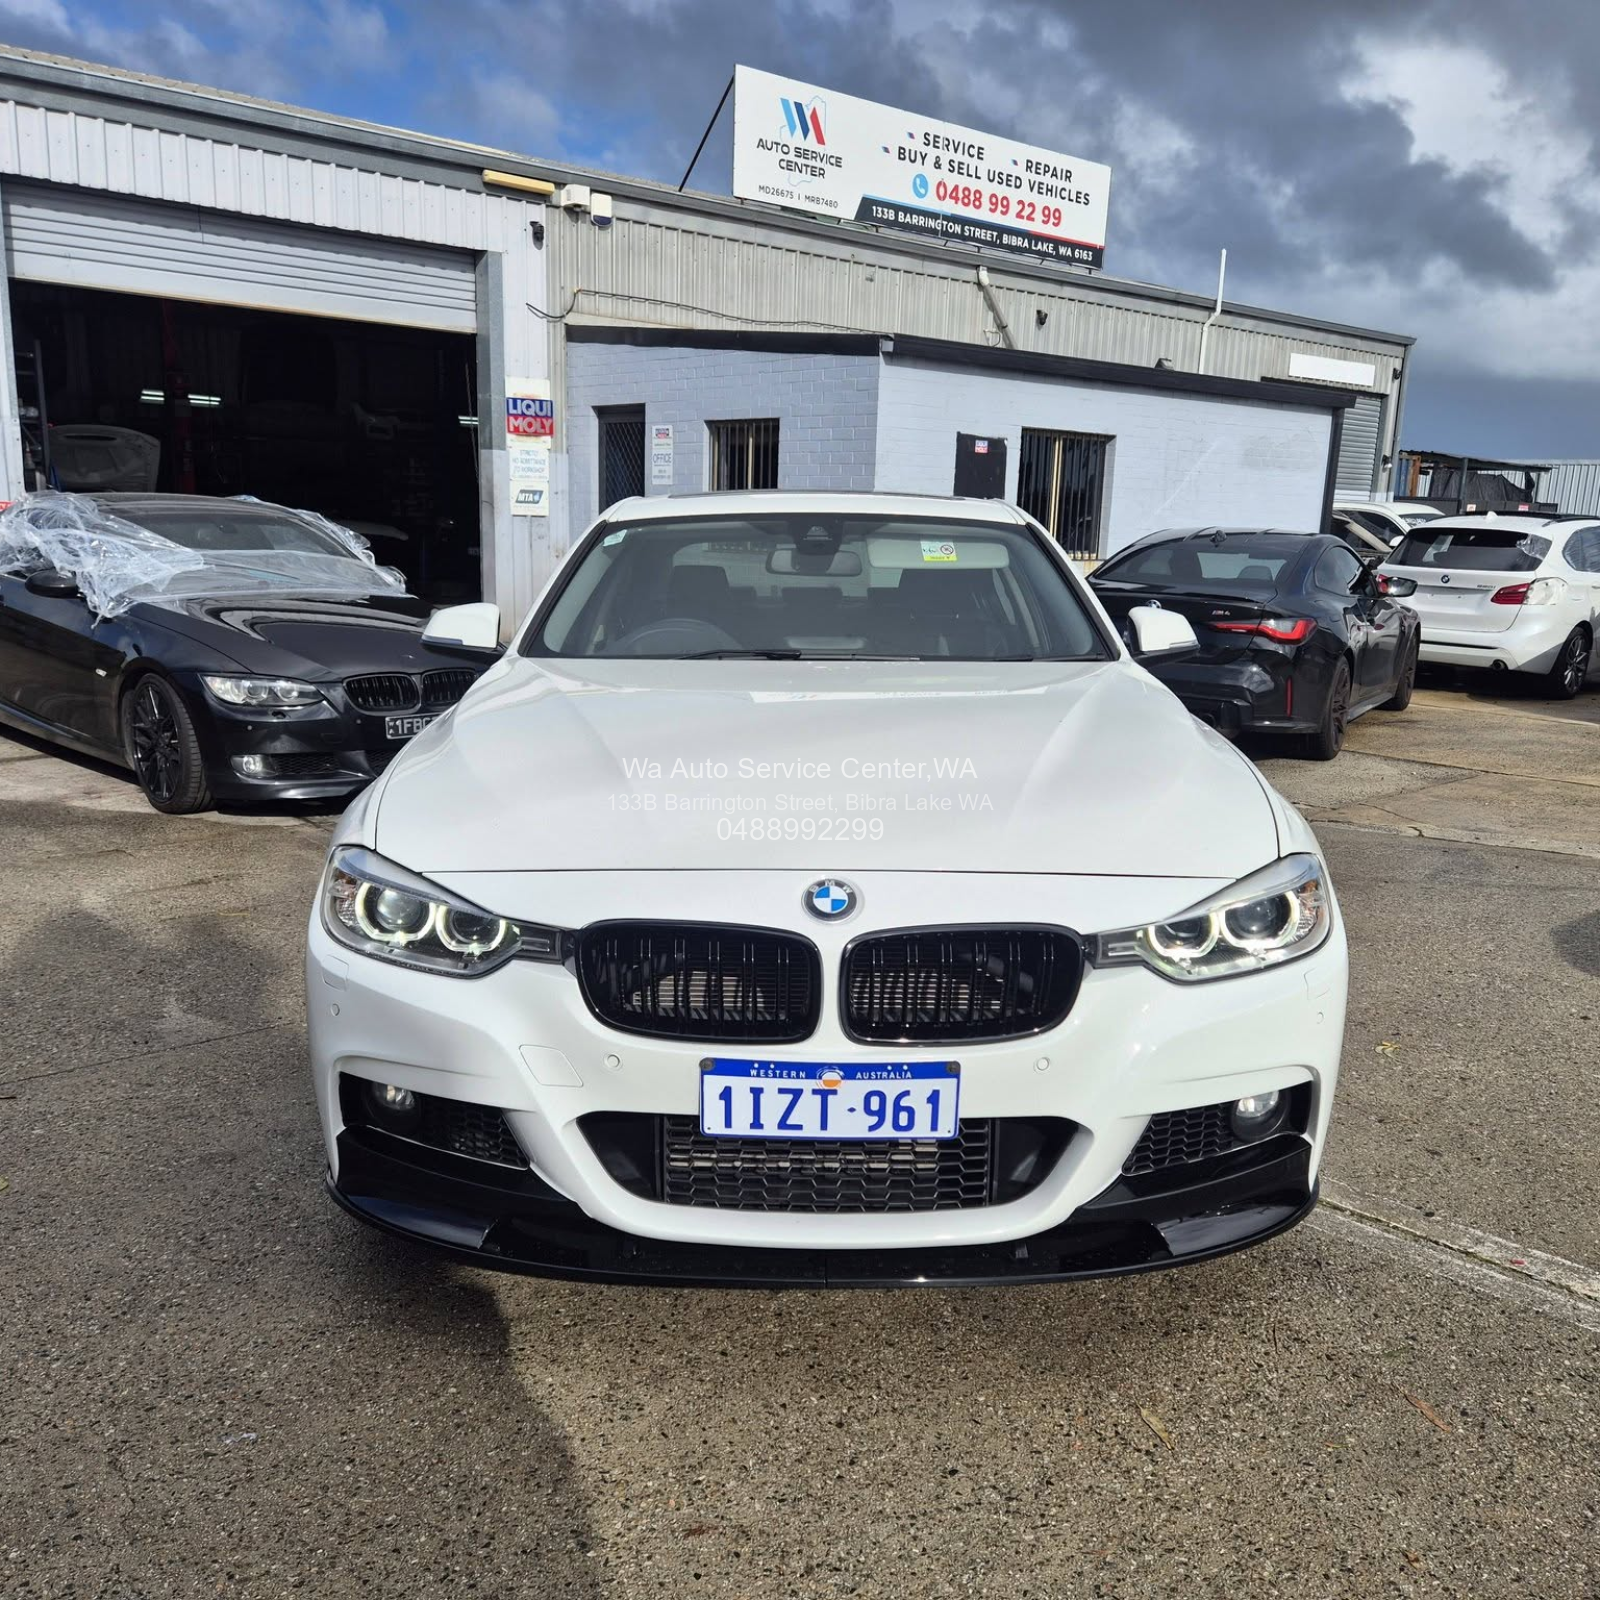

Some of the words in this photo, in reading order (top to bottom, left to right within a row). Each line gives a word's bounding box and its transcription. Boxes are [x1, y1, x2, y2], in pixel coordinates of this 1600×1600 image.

[756, 138, 791, 155] AUTO
[793, 146, 843, 168] SERVICE
[923, 131, 985, 161] SERVICE
[778, 158, 826, 179] CENTER
[897, 145, 928, 166] BUY
[933, 155, 942, 170] &
[948, 159, 982, 180] SELL
[987, 169, 1023, 189] USED
[1027, 178, 1091, 206] VEHICLES
[1025, 159, 1073, 183] REPAIR
[758, 185, 794, 200] MD26675
[804, 194, 839, 209] MRB7480
[935, 180, 983, 210] 0488
[988, 193, 1010, 216] 99
[1015, 200, 1036, 222] 22
[1041, 205, 1062, 227] 99
[872, 205, 895, 220] 133B
[898, 211, 962, 234] BARRINGTON
[963, 225, 1001, 244] STREET,
[1002, 233, 1030, 249] BIBRA
[1031, 240, 1056, 256] LAKE,
[1058, 245, 1073, 257] WA
[1074, 249, 1093, 261] 6163
[508, 398, 552, 417] LIQUI
[508, 416, 552, 434] MOLY
[750, 1069, 806, 1078] WESTERN
